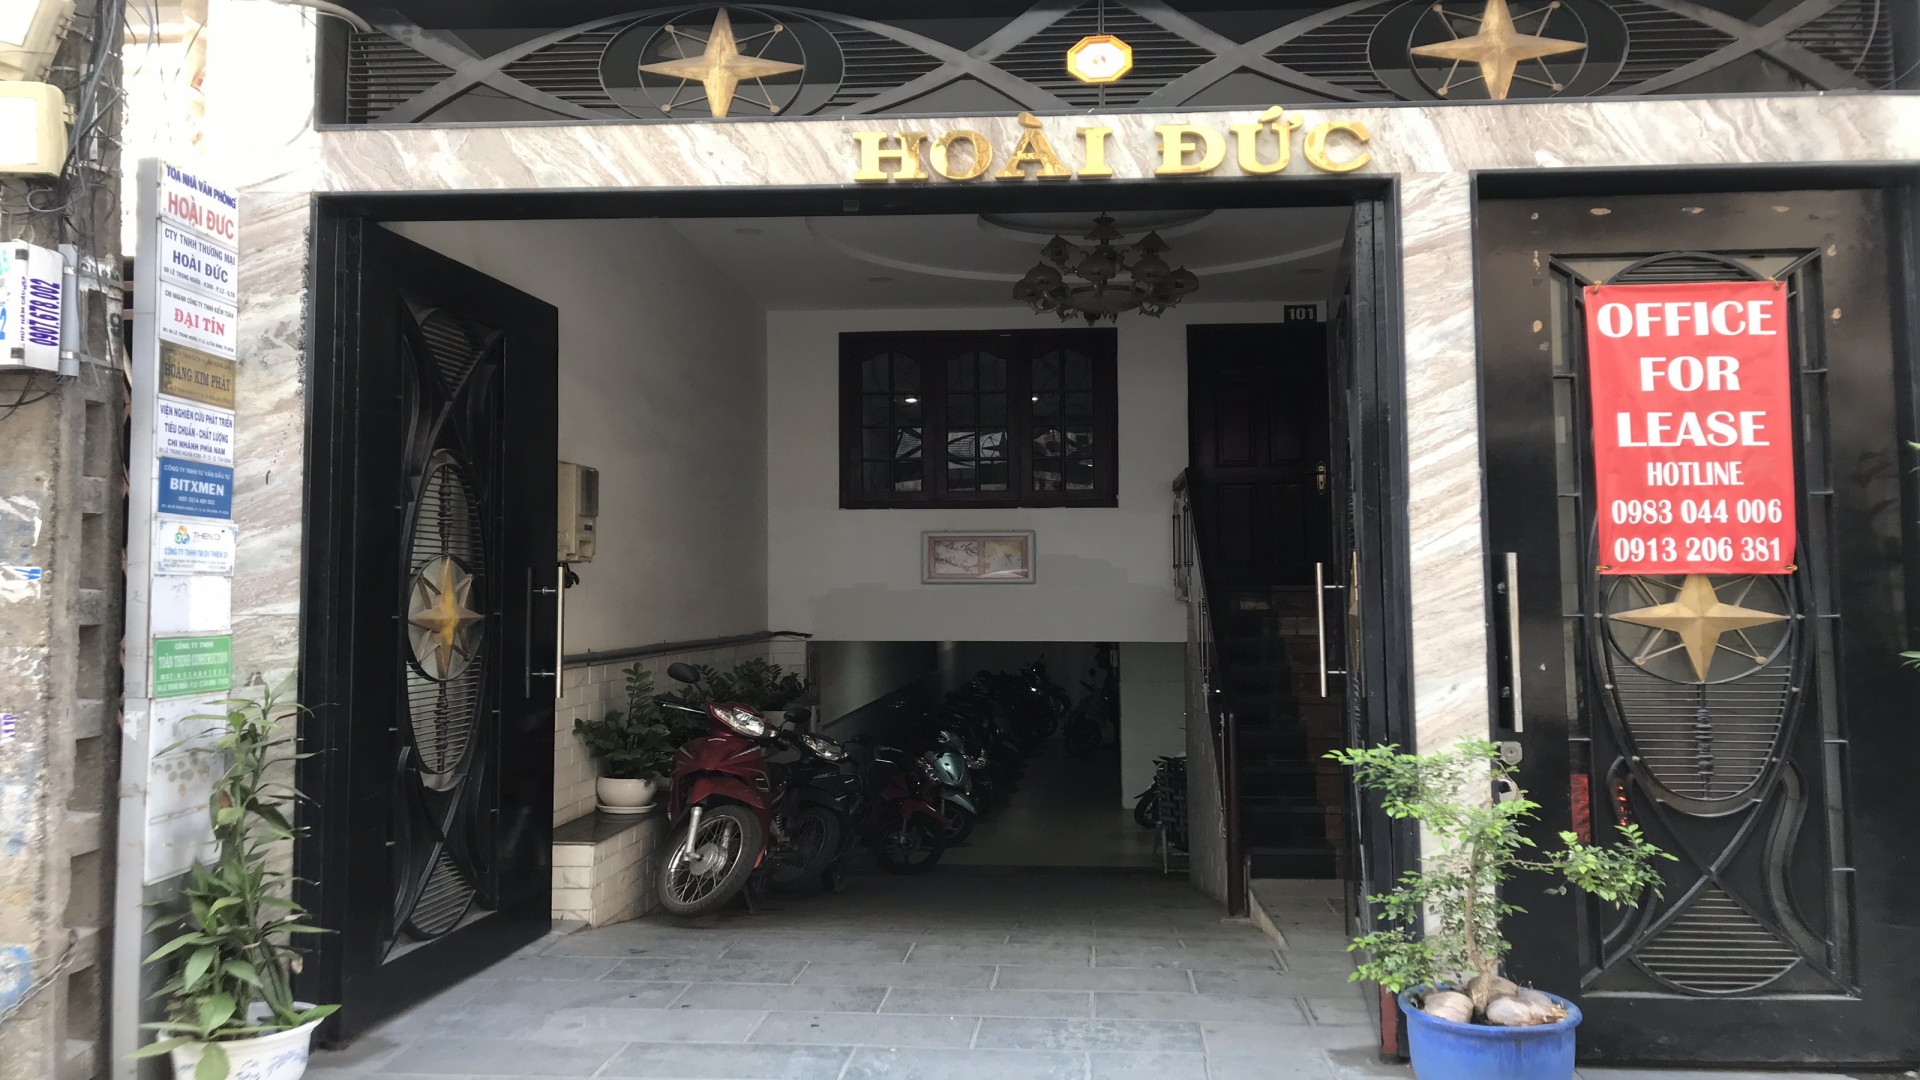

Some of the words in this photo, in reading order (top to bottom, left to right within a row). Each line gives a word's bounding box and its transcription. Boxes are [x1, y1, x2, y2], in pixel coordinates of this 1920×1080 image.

[852, 112, 1113, 182] HOÀI
[1155, 105, 1371, 176] ĐỨC
[165, 228, 177, 241] CTY
[179, 234, 197, 250] TNHH
[198, 242, 223, 261] THƯƠNG
[173, 250, 201, 273] HOÀI
[205, 263, 228, 283] ĐỨC
[28, 278, 60, 347] 0907.678.002
[174, 307, 199, 329] ĐẠI
[202, 316, 225, 337] TÍN
[1288, 308, 1314, 320] 101
[1597, 301, 1777, 338] OFFICE
[194, 370, 209, 386] KIM
[1640, 356, 1741, 392] FOR
[168, 438, 178, 447] CHI
[1617, 411, 1770, 447] LEASE
[170, 477, 225, 496] BITXMEN
[1647, 461, 1744, 487] HOTLINE
[1611, 499, 1673, 525] 0983
[1681, 499, 1729, 524] 044
[1736, 498, 1783, 524] 006
[1614, 537, 1678, 562] 0913
[1685, 537, 1734, 562] 206
[1740, 537, 1781, 562] 381
